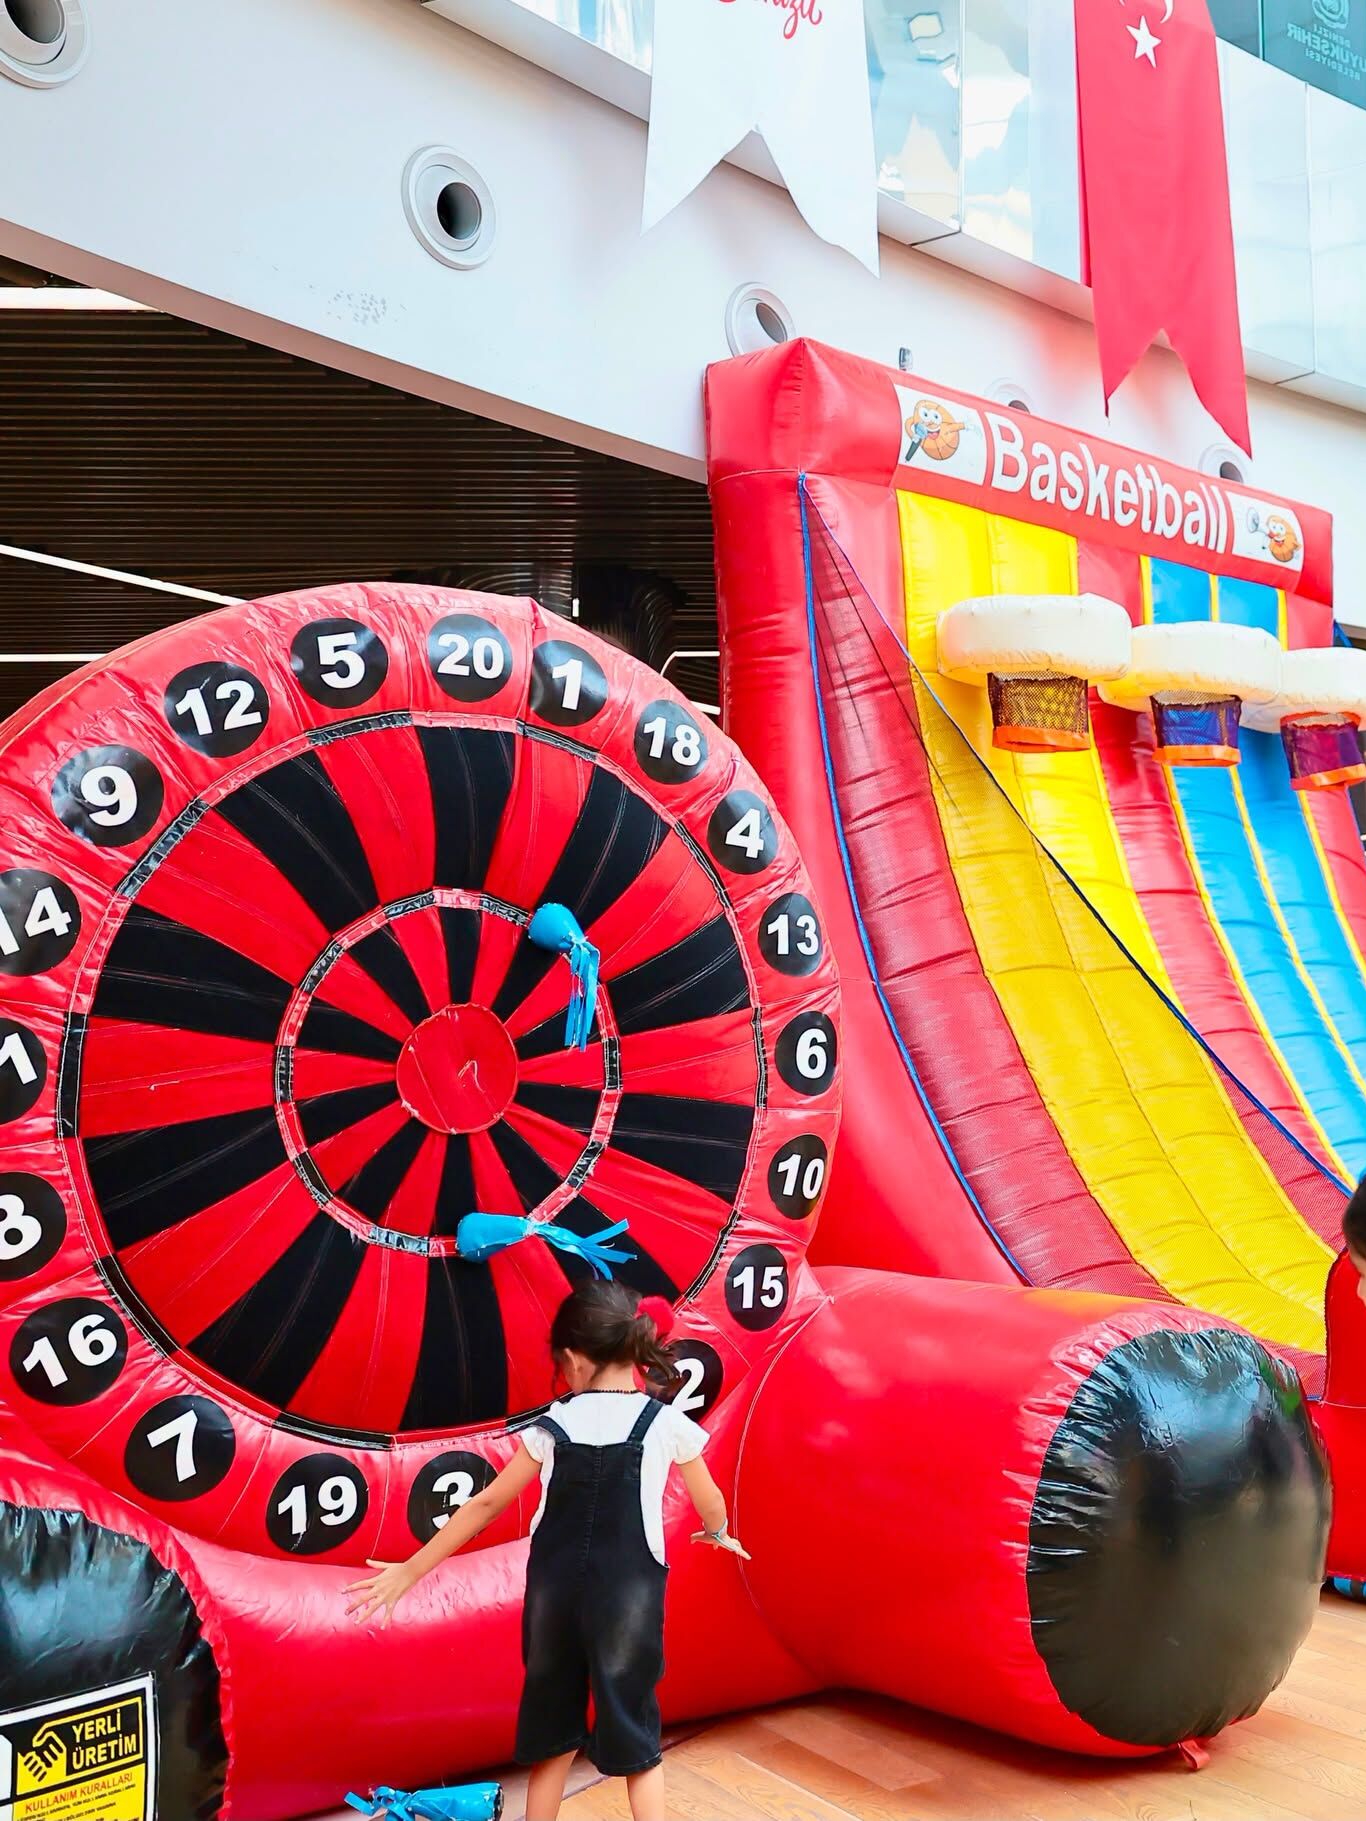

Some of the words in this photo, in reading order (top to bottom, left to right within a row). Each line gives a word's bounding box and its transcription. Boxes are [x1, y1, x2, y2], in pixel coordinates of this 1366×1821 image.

[985, 410, 1229, 555] Basketball
[317, 632, 366, 689] 5
[437, 633, 505, 679] 20
[175, 680, 263, 736] 12
[552, 659, 584, 711] 1
[642, 716, 702, 767] 18
[80, 765, 138, 827] 9
[725, 808, 765, 859] 4
[766, 913, 819, 956] 13
[794, 1027, 828, 1080] 6
[776, 1152, 825, 1200] 10
[0, 1193, 43, 1261] 8
[733, 1265, 785, 1309] 15
[22, 1313, 119, 1388] 16
[671, 1357, 705, 1412] 2
[147, 1410, 200, 1483] 7
[277, 1475, 358, 1535] 19
[432, 1471, 474, 1530] 3
[72, 1708, 121, 1744] YERLİ
[72, 1733, 137, 1770] ÜRETİM
[25, 1790, 78, 1813] KULLANIM
[80, 1772, 133, 1797] KURALLARI
